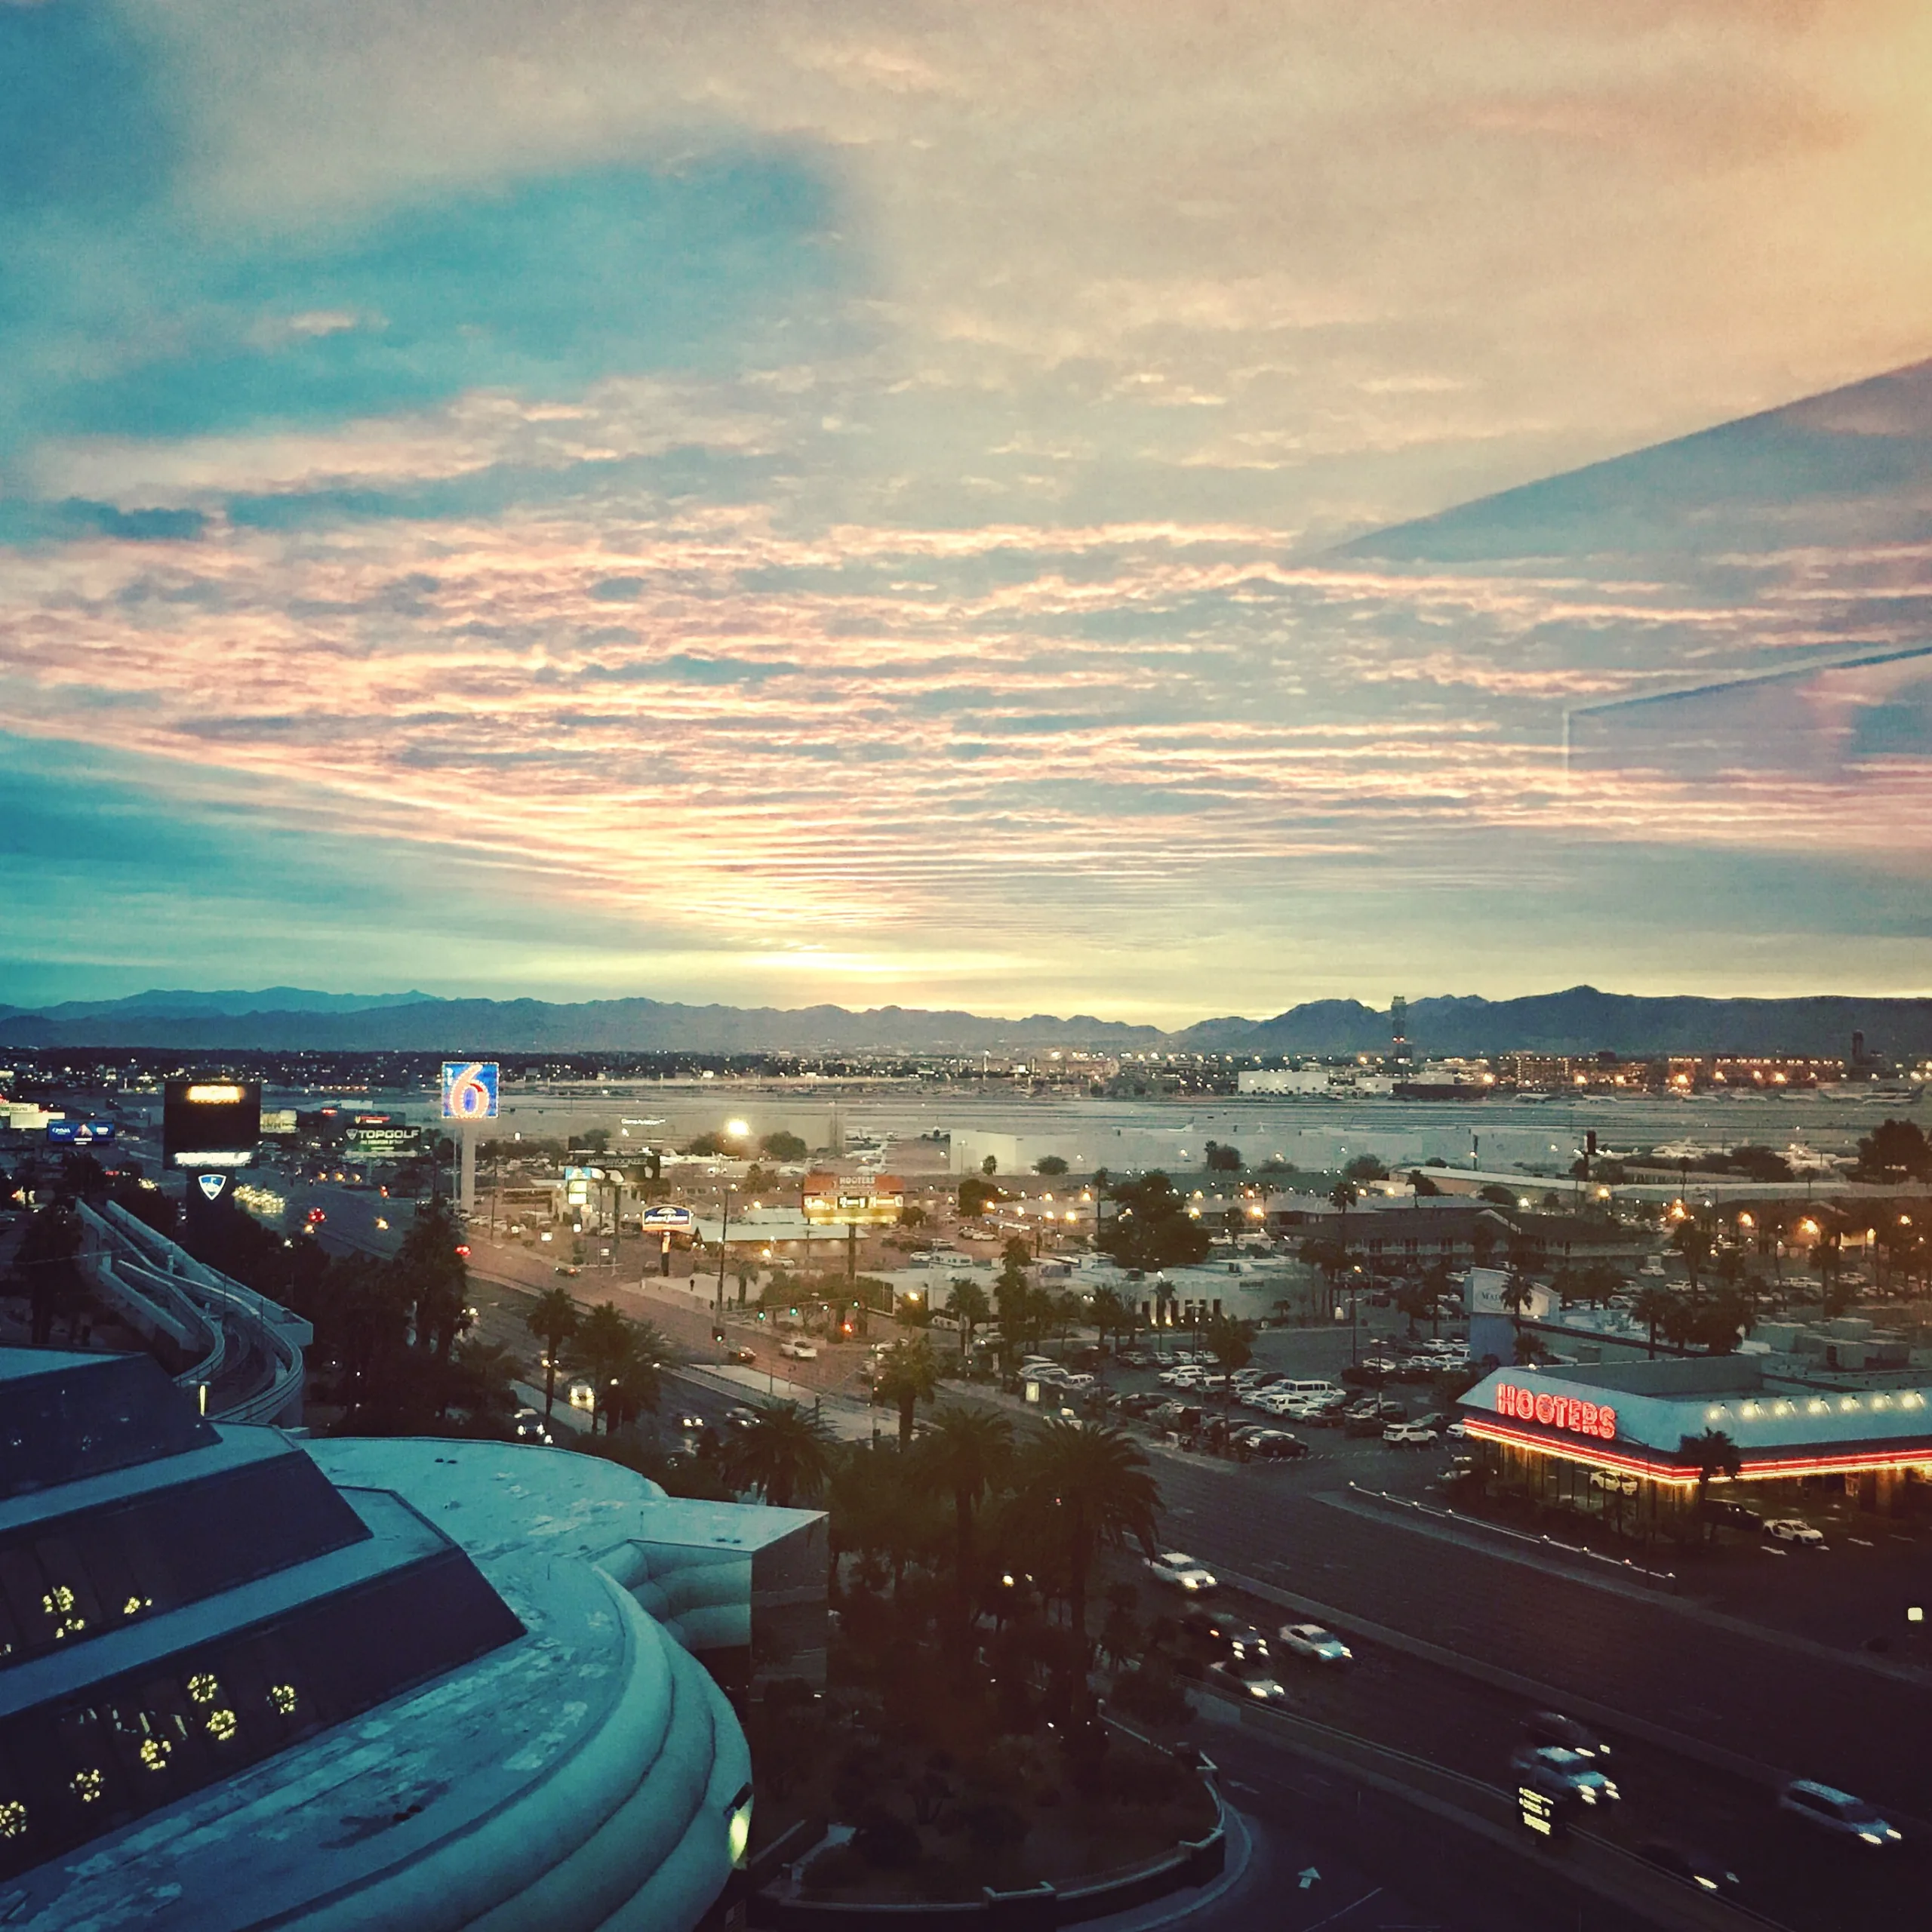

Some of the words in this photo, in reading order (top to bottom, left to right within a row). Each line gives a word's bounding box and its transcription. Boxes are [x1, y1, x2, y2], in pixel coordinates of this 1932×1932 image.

[450, 1064, 490, 1118] 6
[359, 1130, 419, 1139] TOPGOLF
[839, 1177, 875, 1185] HOOTERS
[1497, 1383, 1617, 1440] HOOTERS
